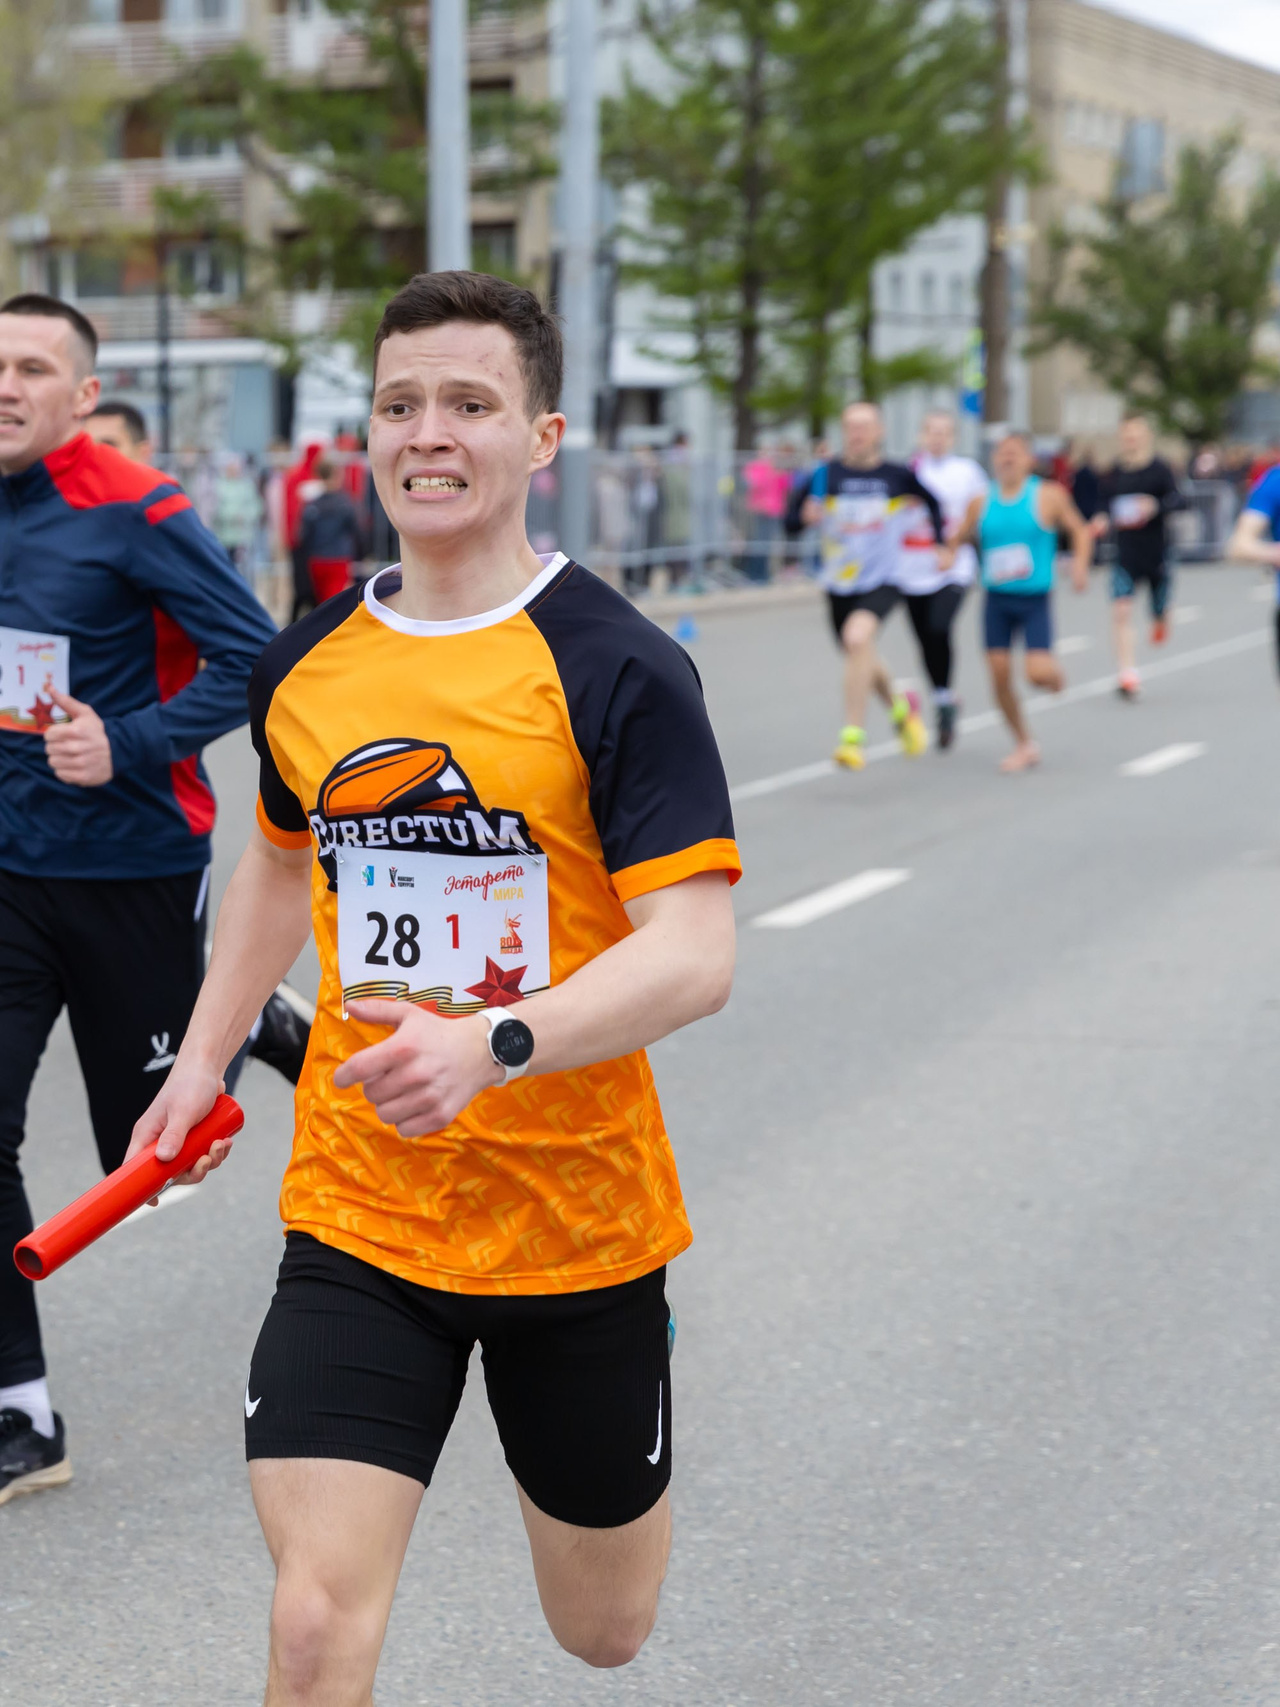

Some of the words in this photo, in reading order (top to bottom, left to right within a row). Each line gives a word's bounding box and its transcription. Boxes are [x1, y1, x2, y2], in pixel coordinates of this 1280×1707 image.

[17, 665, 25, 685] 1
[310, 810, 535, 856] DIRECTUM
[444, 865, 525, 901] Эстафета
[493, 887, 524, 901] МИРА
[365, 911, 421, 968] 28
[445, 914, 459, 949] 1
